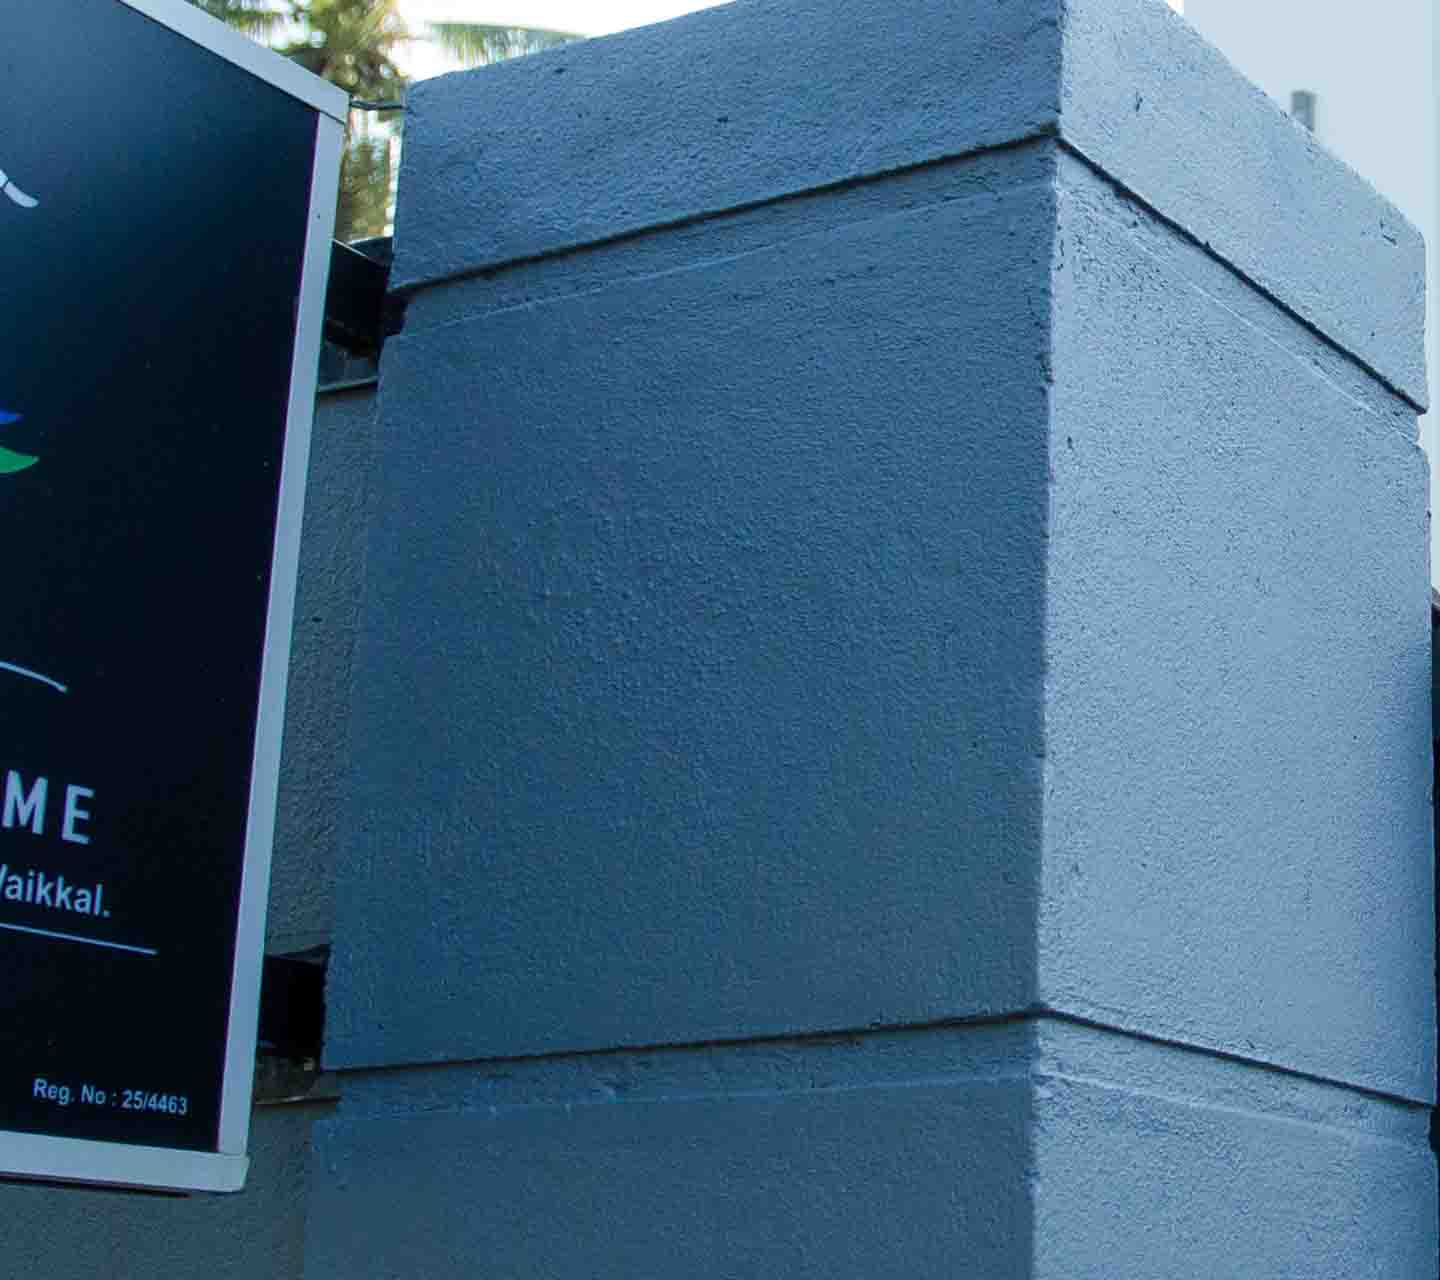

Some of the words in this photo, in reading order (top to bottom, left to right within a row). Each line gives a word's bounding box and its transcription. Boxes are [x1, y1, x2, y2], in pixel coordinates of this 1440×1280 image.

[32, 1077, 75, 1107] Reg.
[80, 1084, 107, 1105] No
[121, 1089, 189, 1116] 25/4463
